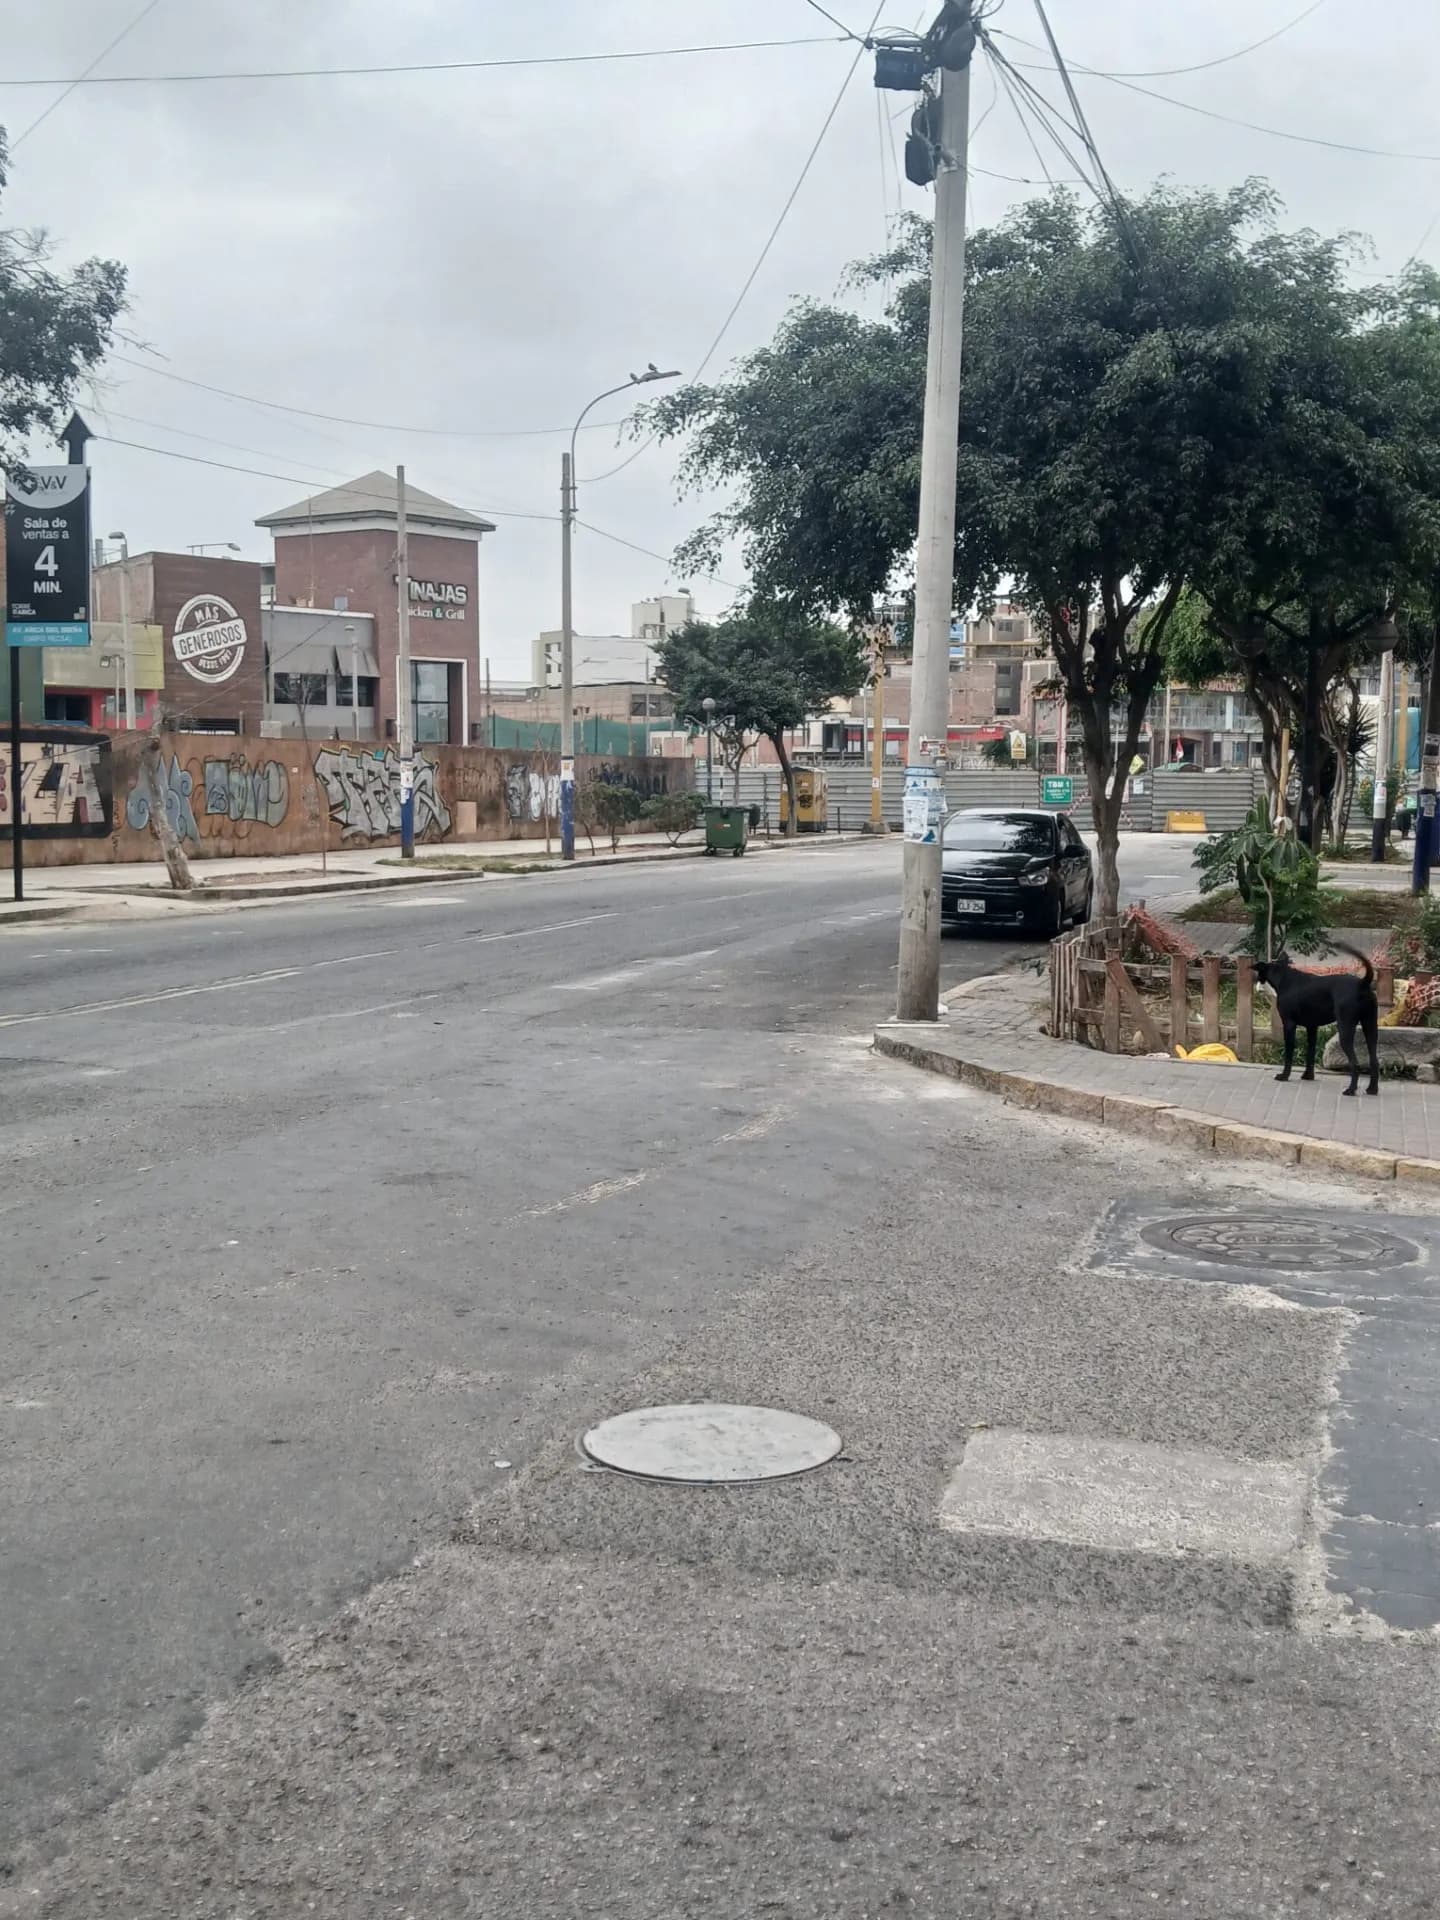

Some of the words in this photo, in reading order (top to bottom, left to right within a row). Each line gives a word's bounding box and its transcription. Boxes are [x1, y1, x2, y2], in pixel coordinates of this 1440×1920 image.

[24, 518, 49, 529] Sala
[51, 518, 68, 528] de
[22, 529, 59, 540] ventas
[61, 530, 70, 540] a
[34, 545, 59, 577] 4
[194, 603, 219, 624] MÁS
[434, 607, 444, 619] &
[445, 608, 465, 620] Grill
[179, 624, 242, 656] GENEROSOS
